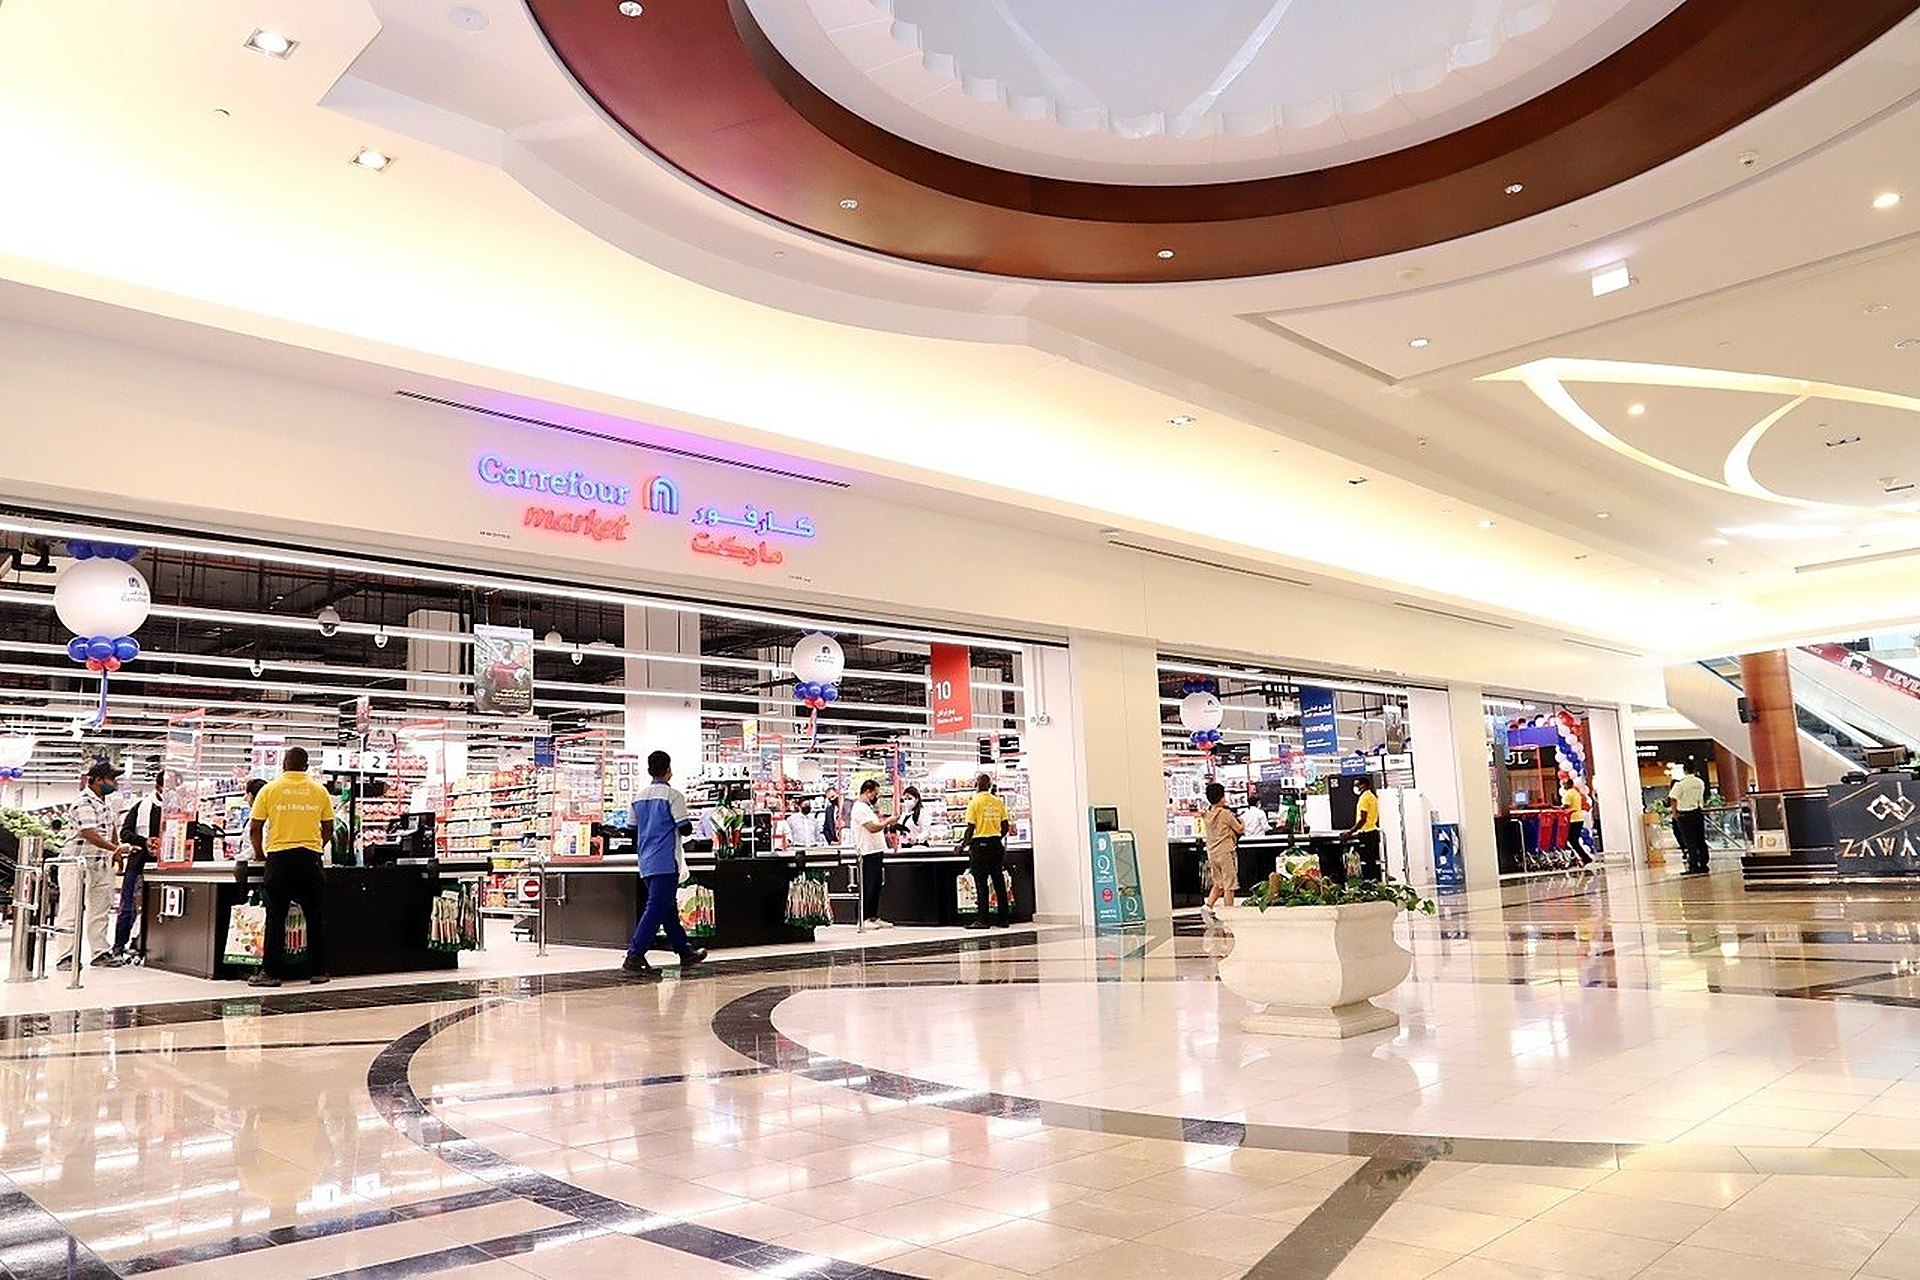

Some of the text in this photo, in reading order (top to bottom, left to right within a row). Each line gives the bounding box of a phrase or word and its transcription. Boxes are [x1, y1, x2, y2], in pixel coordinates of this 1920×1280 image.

[478, 453, 631, 506] Carrefour
[523, 507, 631, 541] market
[690, 505, 816, 538] كارفور
[691, 533, 783, 566] ماركت
[935, 681, 952, 700] 10
[372, 756, 381, 769] 2
